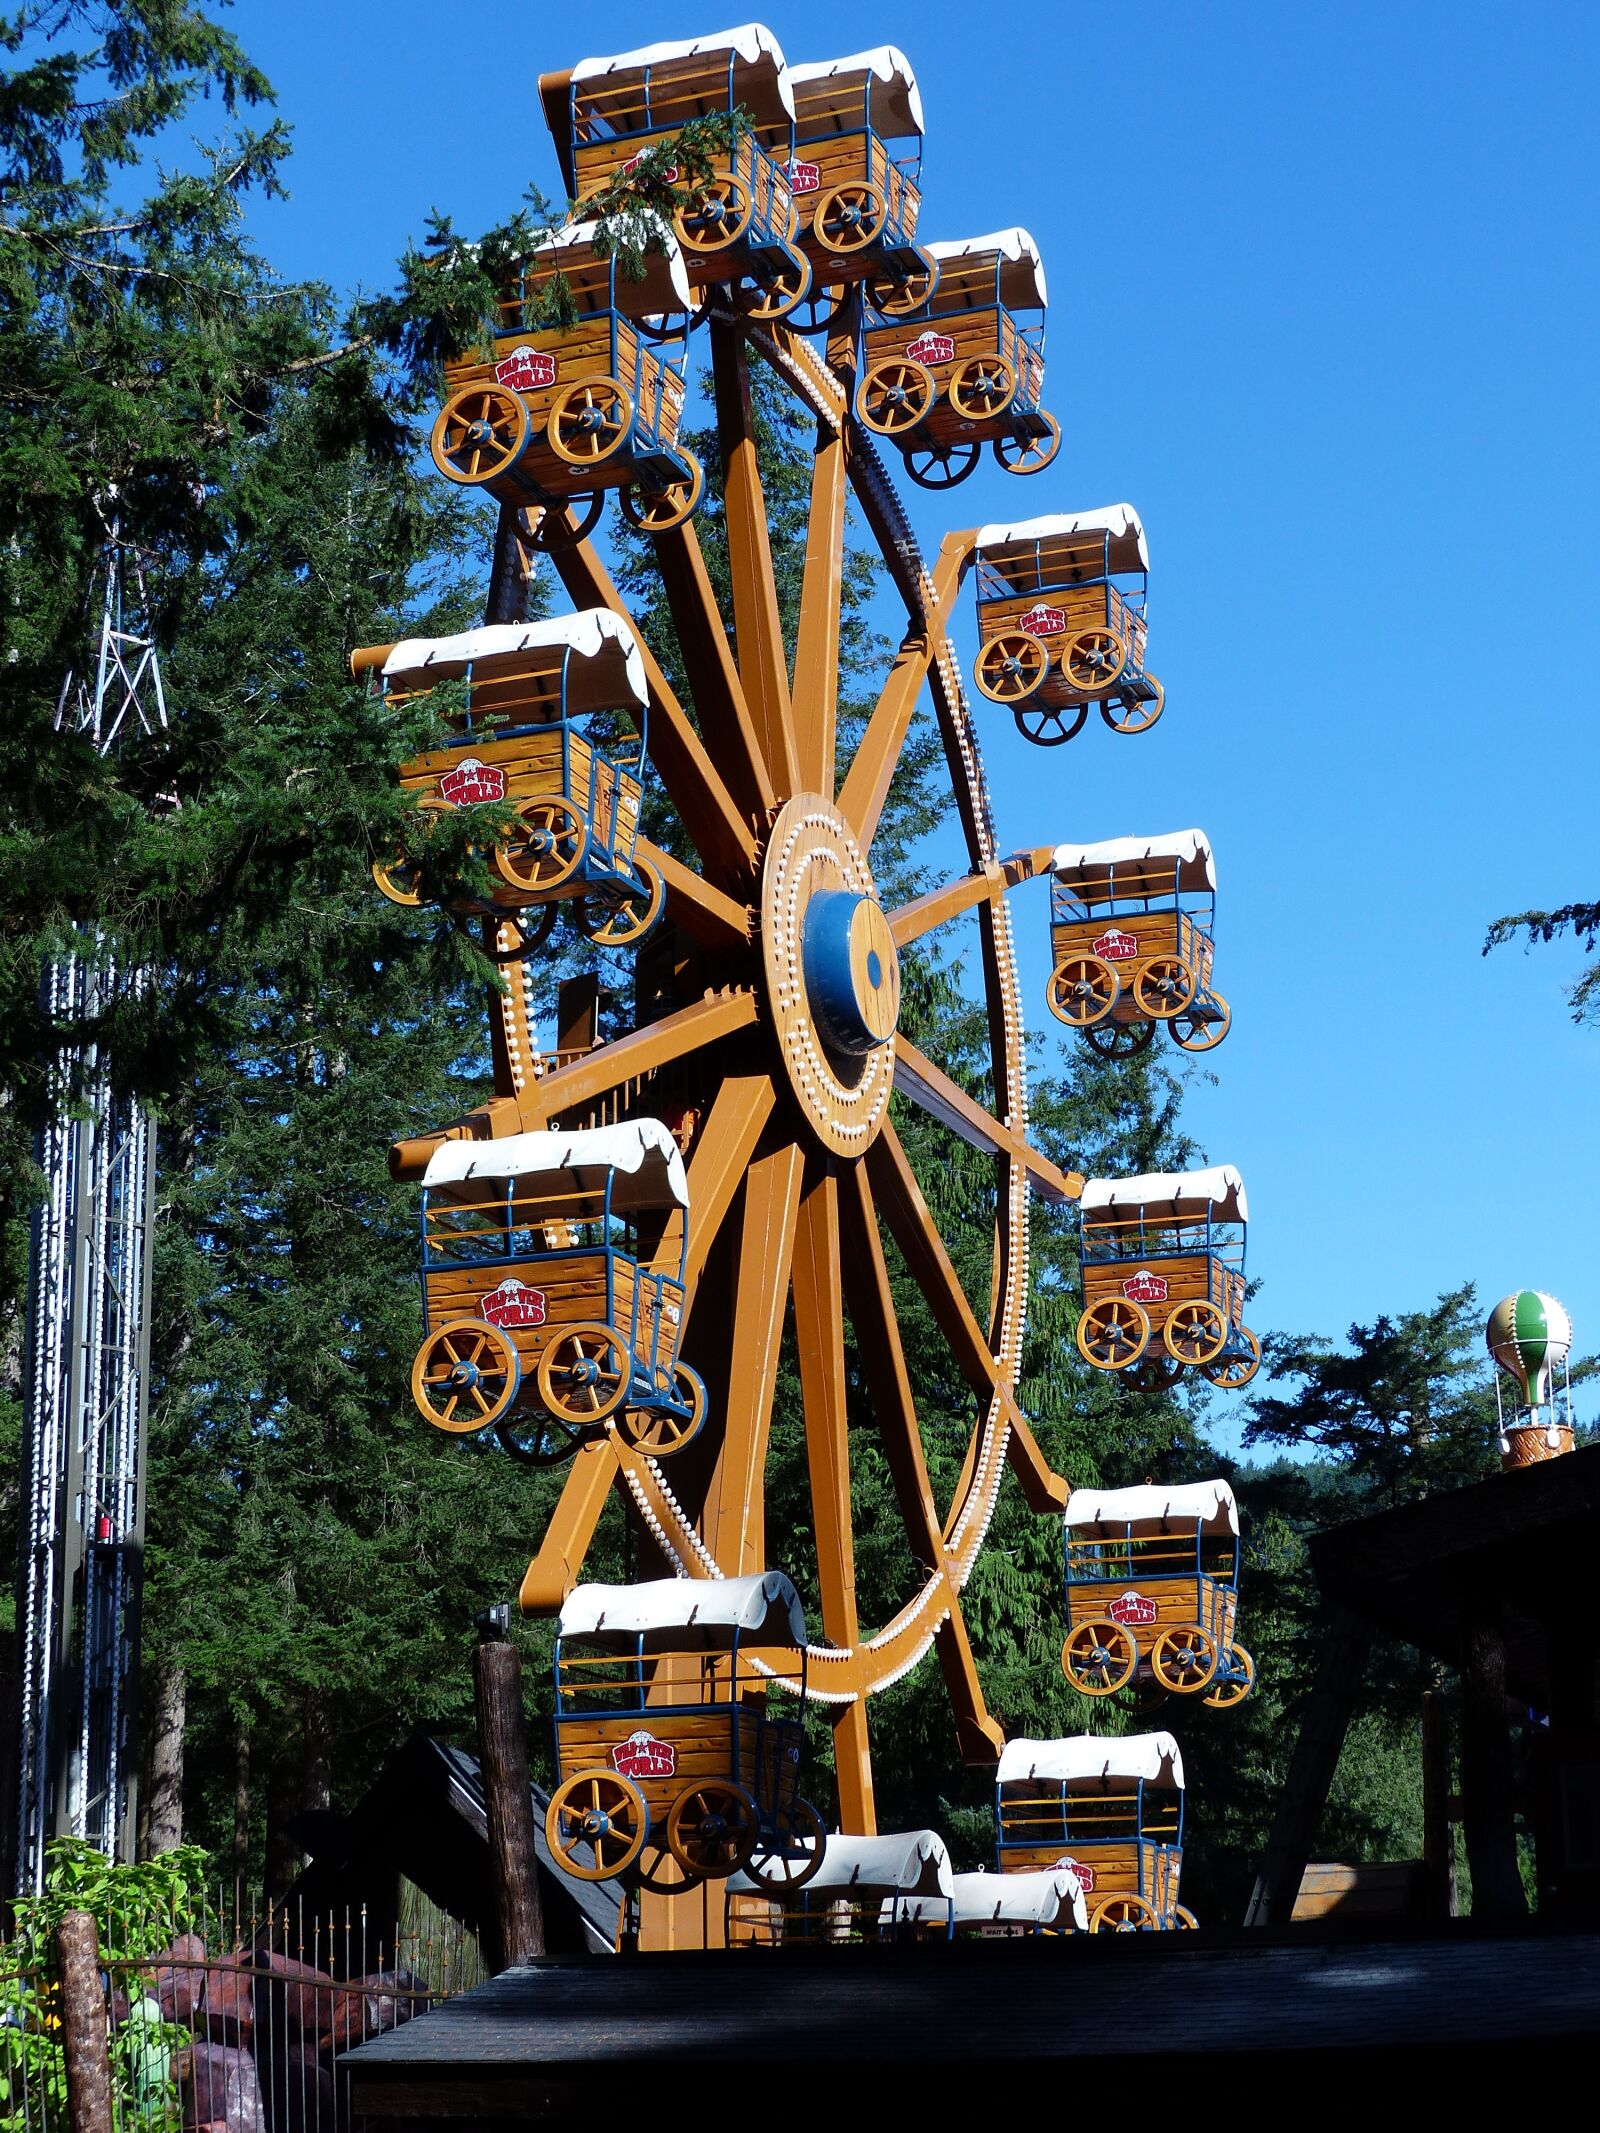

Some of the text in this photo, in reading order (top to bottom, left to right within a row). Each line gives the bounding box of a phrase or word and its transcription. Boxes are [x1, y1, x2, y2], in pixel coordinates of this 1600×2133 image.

[497, 354, 554, 379] WILD WEST
[442, 767, 502, 793] WILD WEST
[483, 1288, 544, 1312] WILD WEST
[613, 1741, 673, 1763] WILD WEST
[616, 1756, 674, 1777] WORLD
